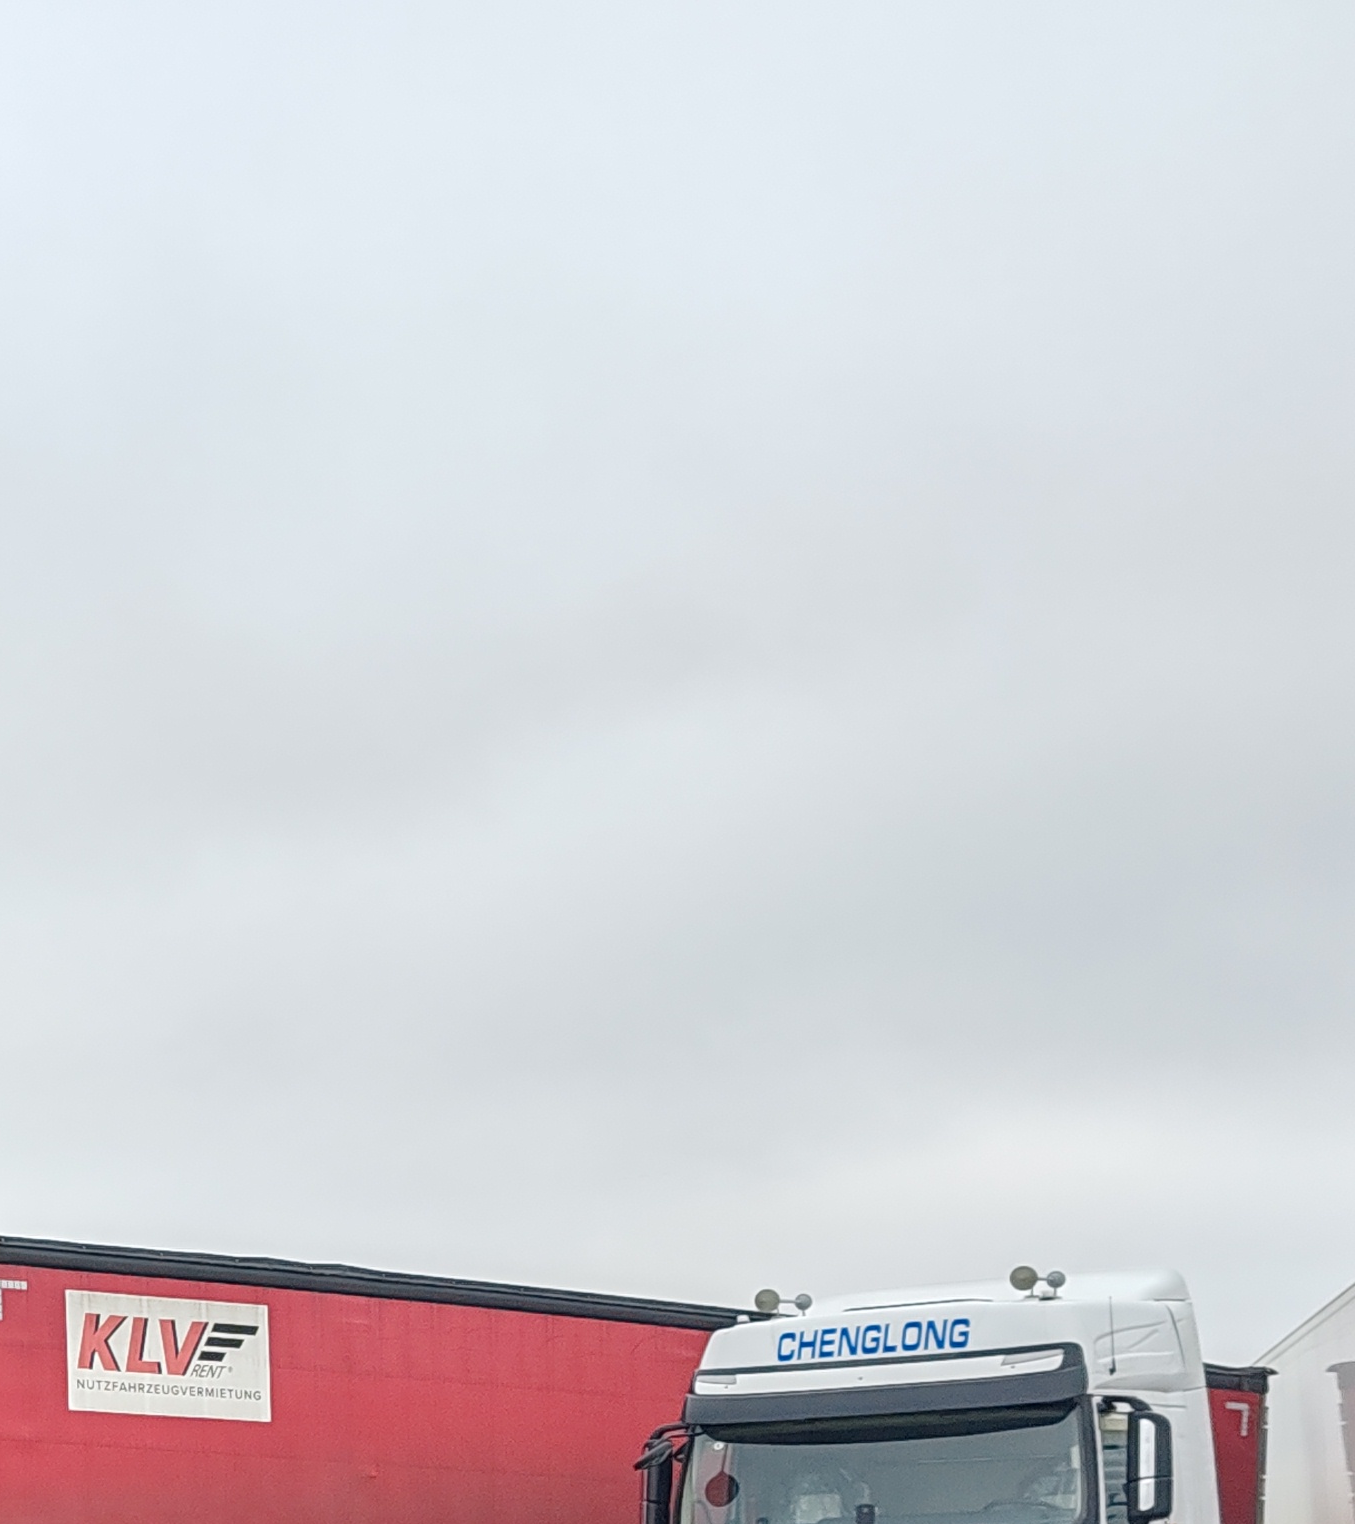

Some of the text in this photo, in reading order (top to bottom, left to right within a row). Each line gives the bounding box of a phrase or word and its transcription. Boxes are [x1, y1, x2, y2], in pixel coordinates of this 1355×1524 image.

[77, 1312, 209, 1377] KLV
[777, 1318, 971, 1362] CHENGLONG
[191, 1364, 226, 1380] RENT
[76, 1379, 262, 1401] NUTZFAHRZEUGVERMIETUNG
